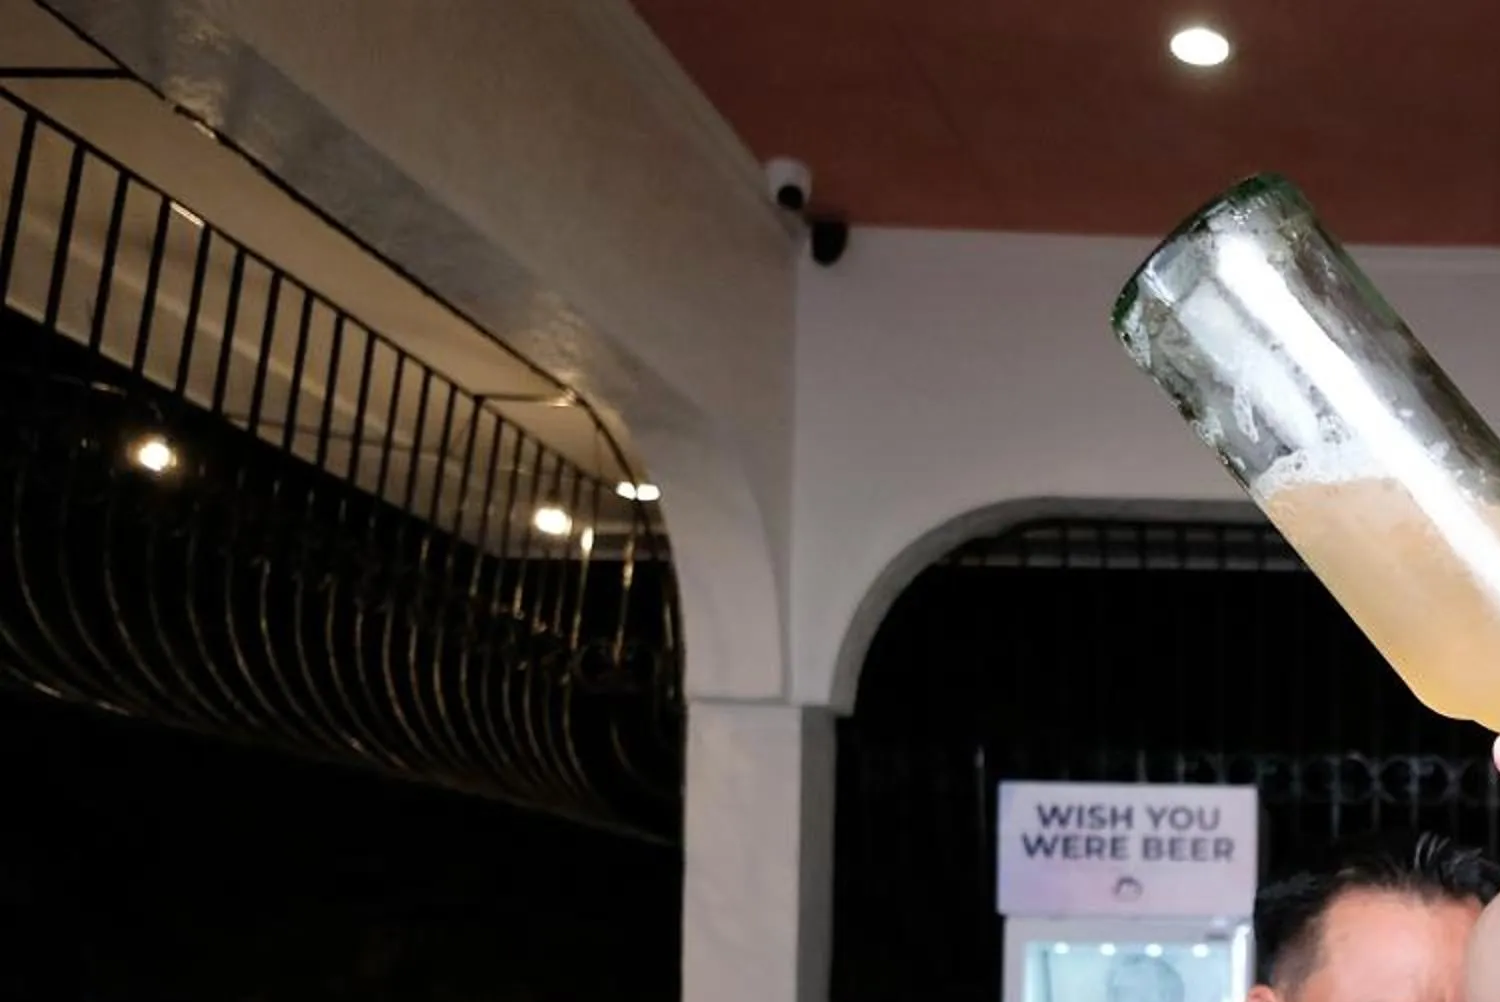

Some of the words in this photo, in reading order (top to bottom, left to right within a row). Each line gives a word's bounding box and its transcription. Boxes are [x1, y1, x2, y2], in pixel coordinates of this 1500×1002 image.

[1036, 803, 1134, 829] WISH
[1146, 806, 1221, 831] YOU
[1021, 833, 1130, 859] WERE
[1142, 836, 1235, 862] BEER
